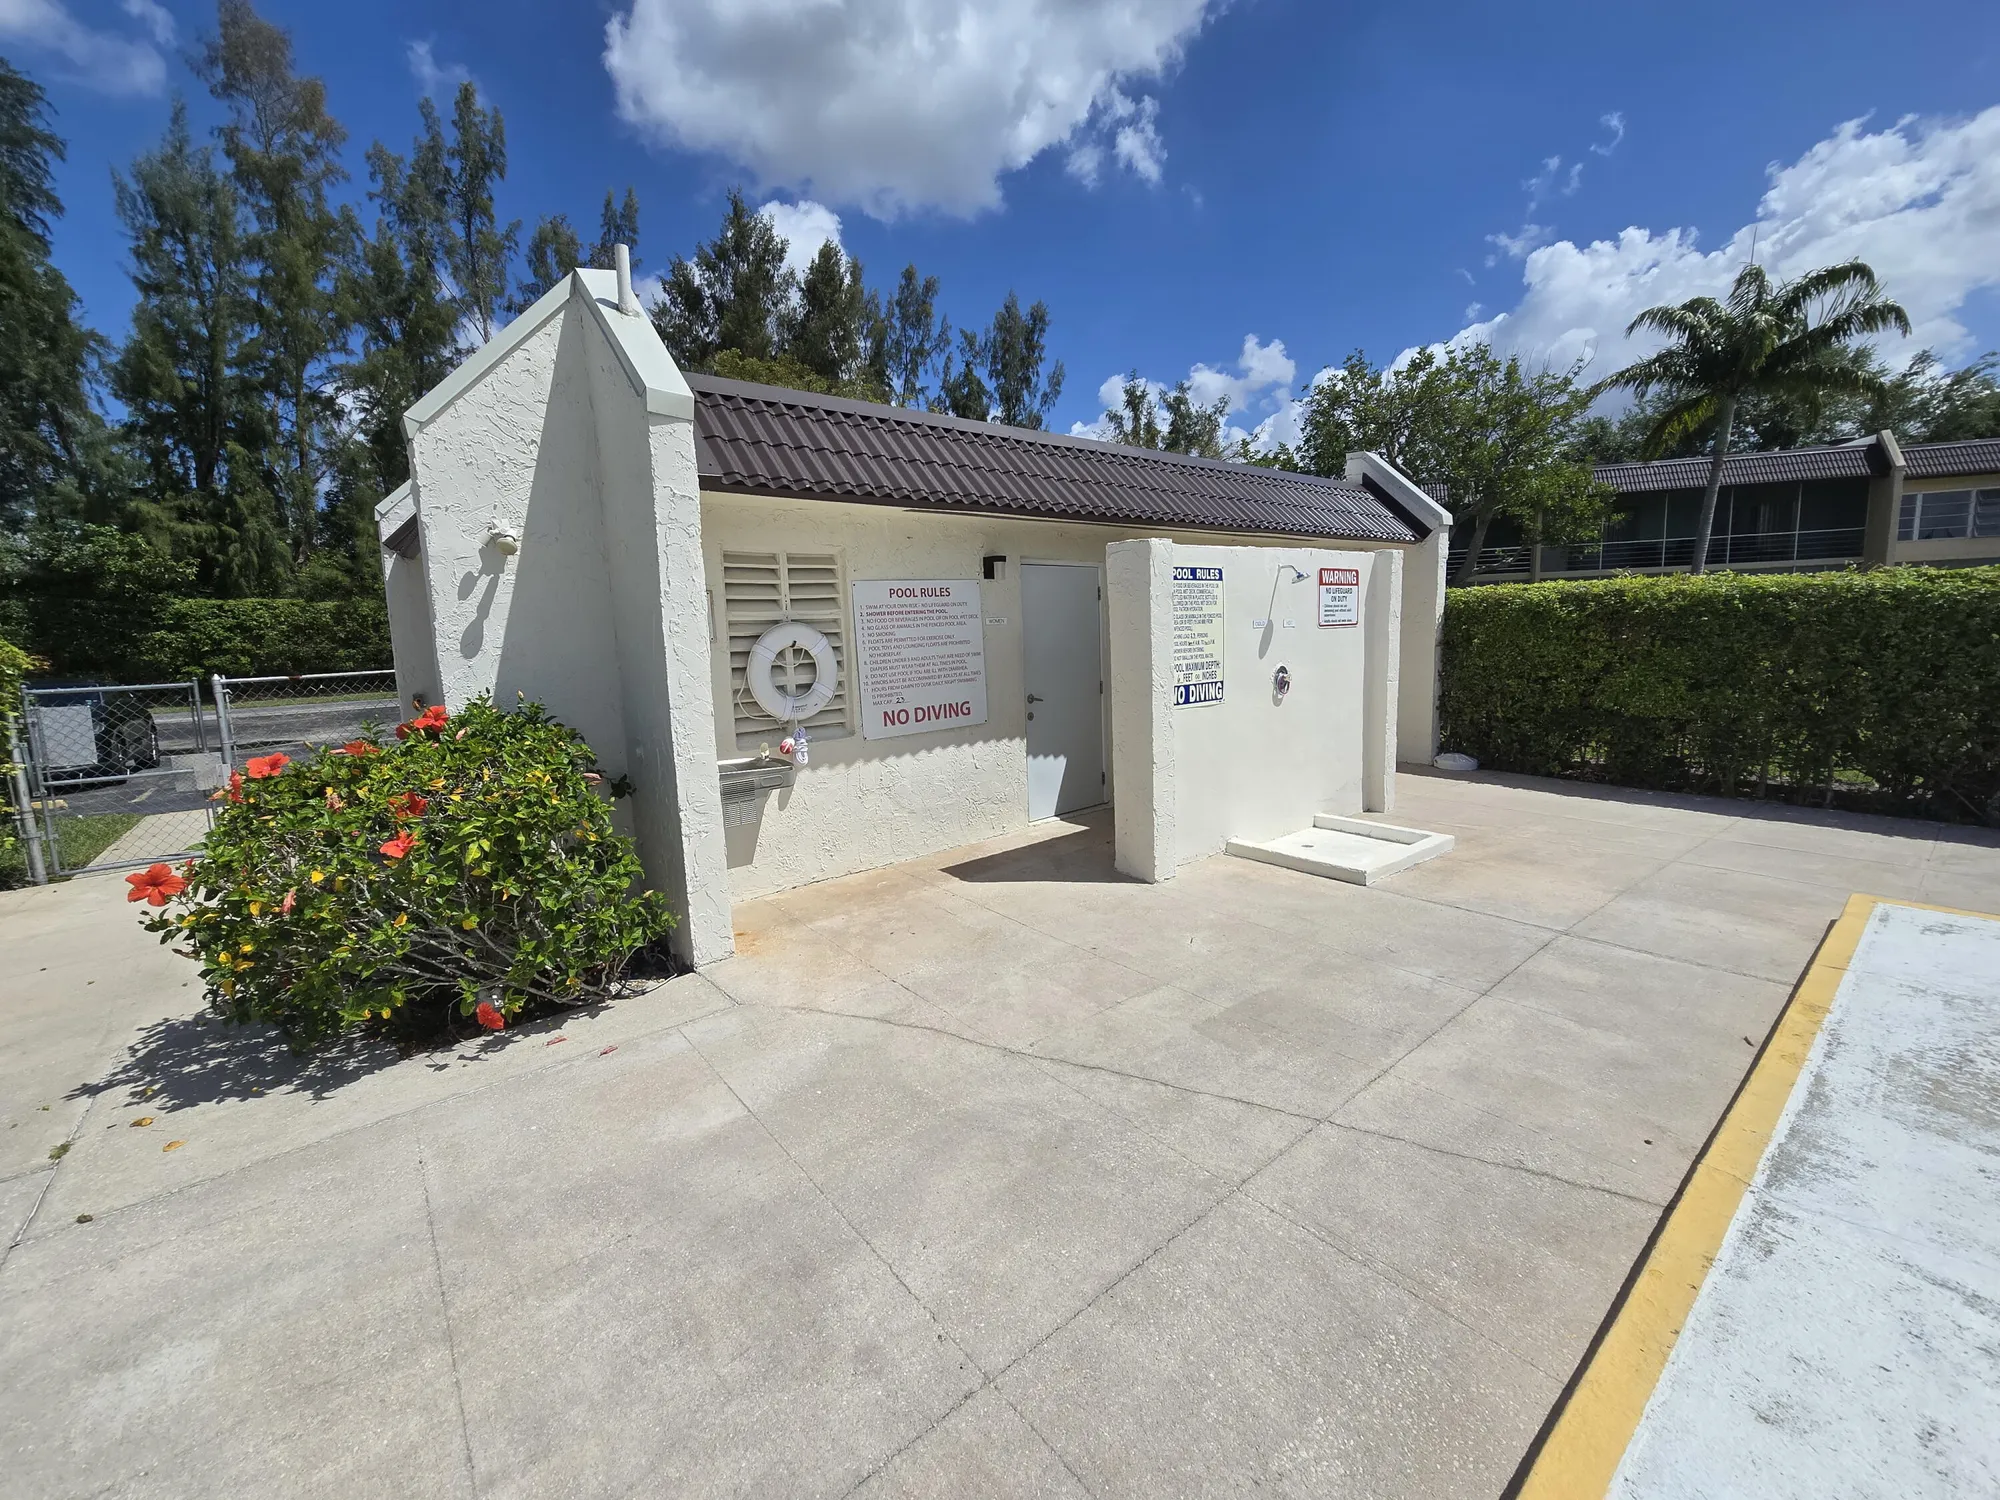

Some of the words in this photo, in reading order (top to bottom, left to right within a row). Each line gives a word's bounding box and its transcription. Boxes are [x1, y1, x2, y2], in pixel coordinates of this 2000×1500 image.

[1196, 568, 1219, 580] RULES
[1322, 570, 1357, 584] WARNING
[889, 587, 918, 598] POOL
[920, 586, 950, 598] RULES
[1185, 661, 1204, 672] MAXIMUM
[1183, 672, 1193, 682] FEET
[1202, 670, 1218, 680] INCHES
[1189, 682, 1223, 702] DIVING
[882, 709, 910, 727] NO
[914, 700, 971, 723] DIVING
